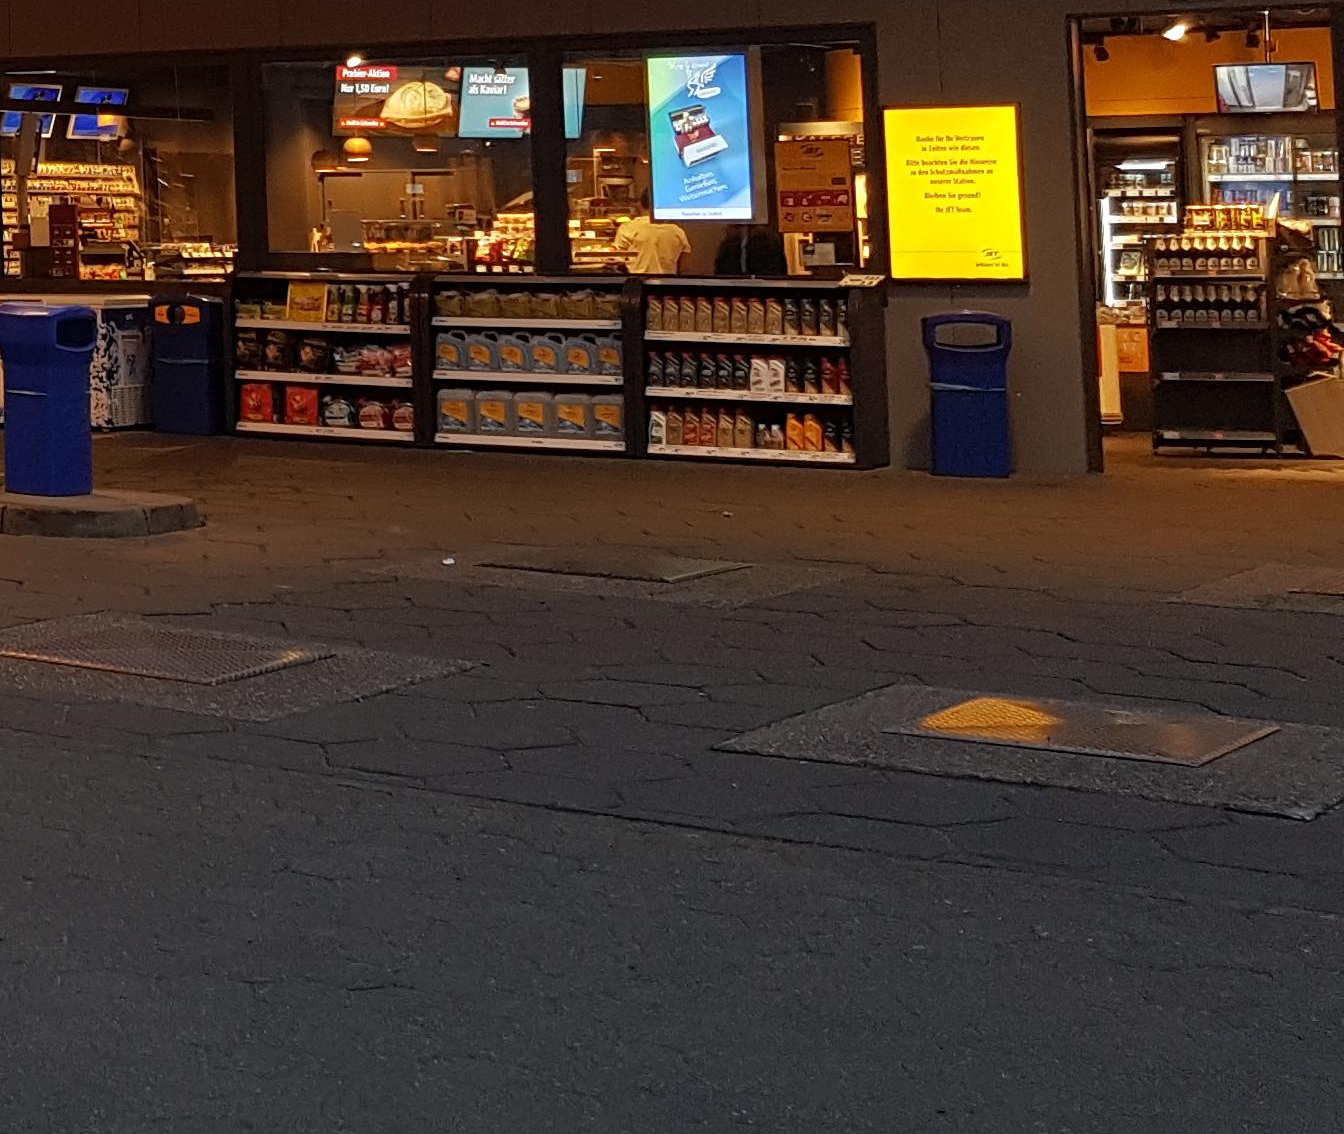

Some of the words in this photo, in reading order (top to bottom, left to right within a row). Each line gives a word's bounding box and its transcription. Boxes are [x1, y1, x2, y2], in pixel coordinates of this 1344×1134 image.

[468, 74, 493, 85] Macht
[468, 85, 479, 95] als
[479, 85, 507, 96] Kaviar!
